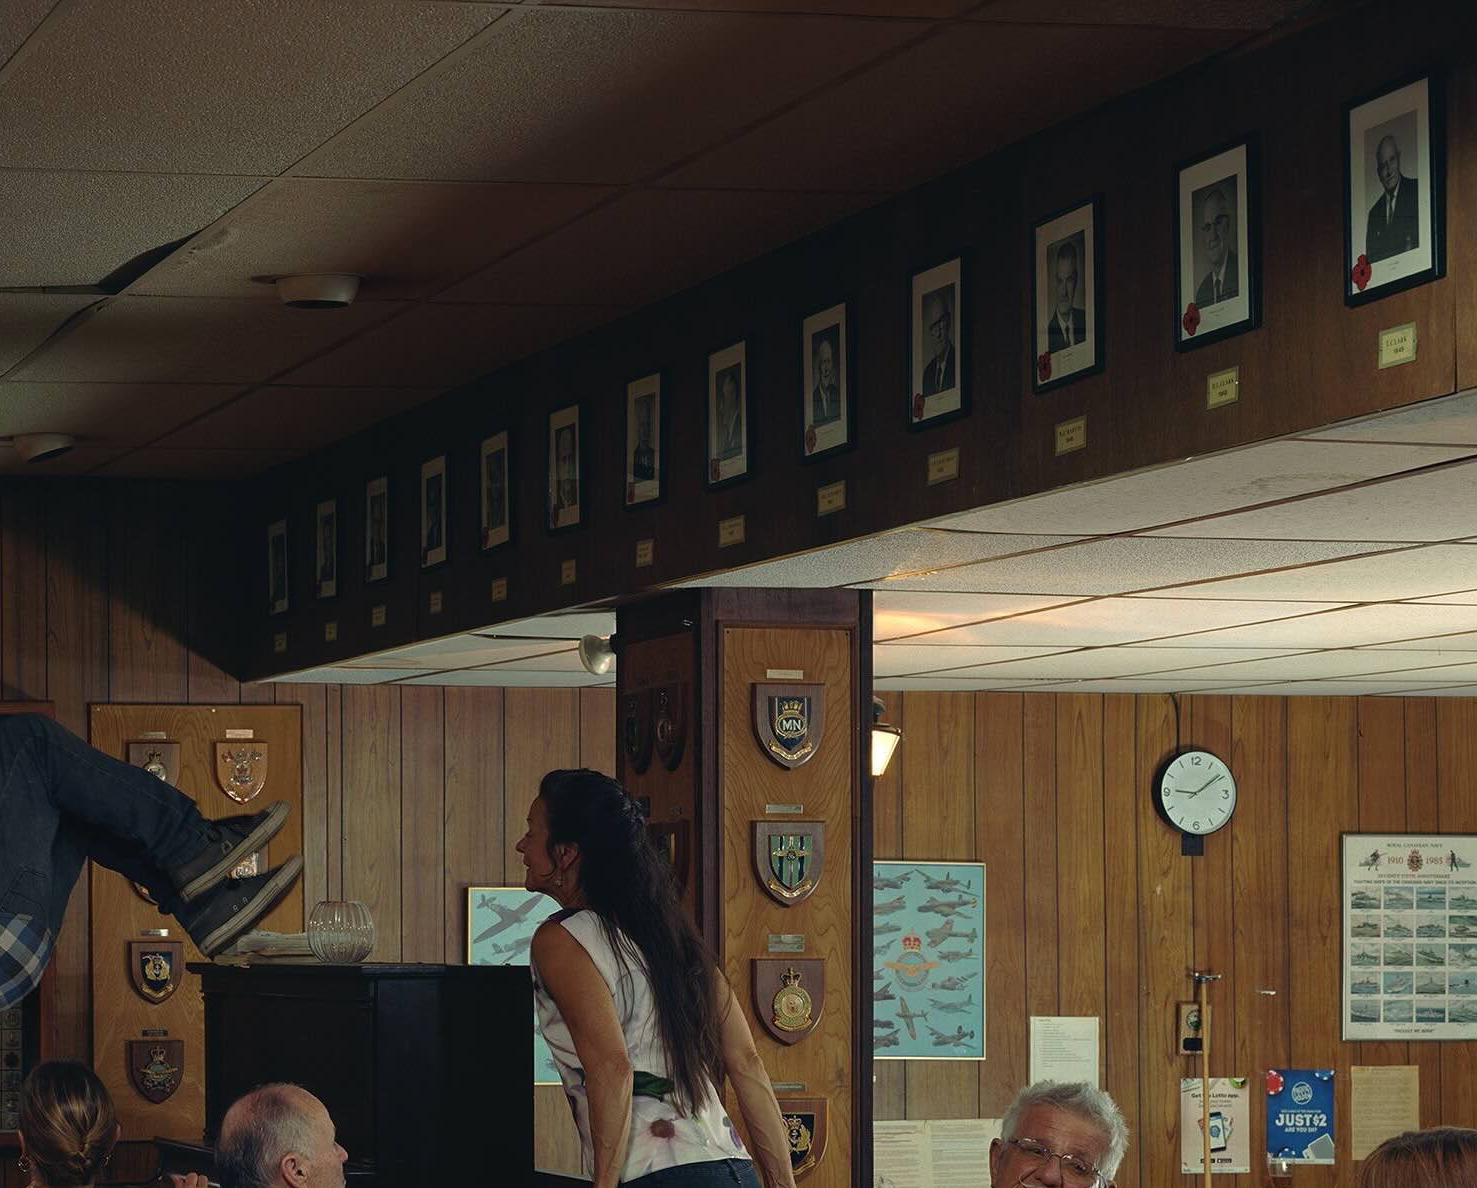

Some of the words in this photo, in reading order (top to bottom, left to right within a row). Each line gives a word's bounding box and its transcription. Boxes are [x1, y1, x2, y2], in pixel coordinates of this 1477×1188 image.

[782, 719, 802, 731] MN
[1191, 756, 1202, 766] 12
[1163, 787, 1170, 797] 9
[1222, 790, 1229, 799] 3
[1192, 821, 1200, 831] 6
[1387, 856, 1404, 864] 1910
[1426, 856, 1443, 864] 1985
